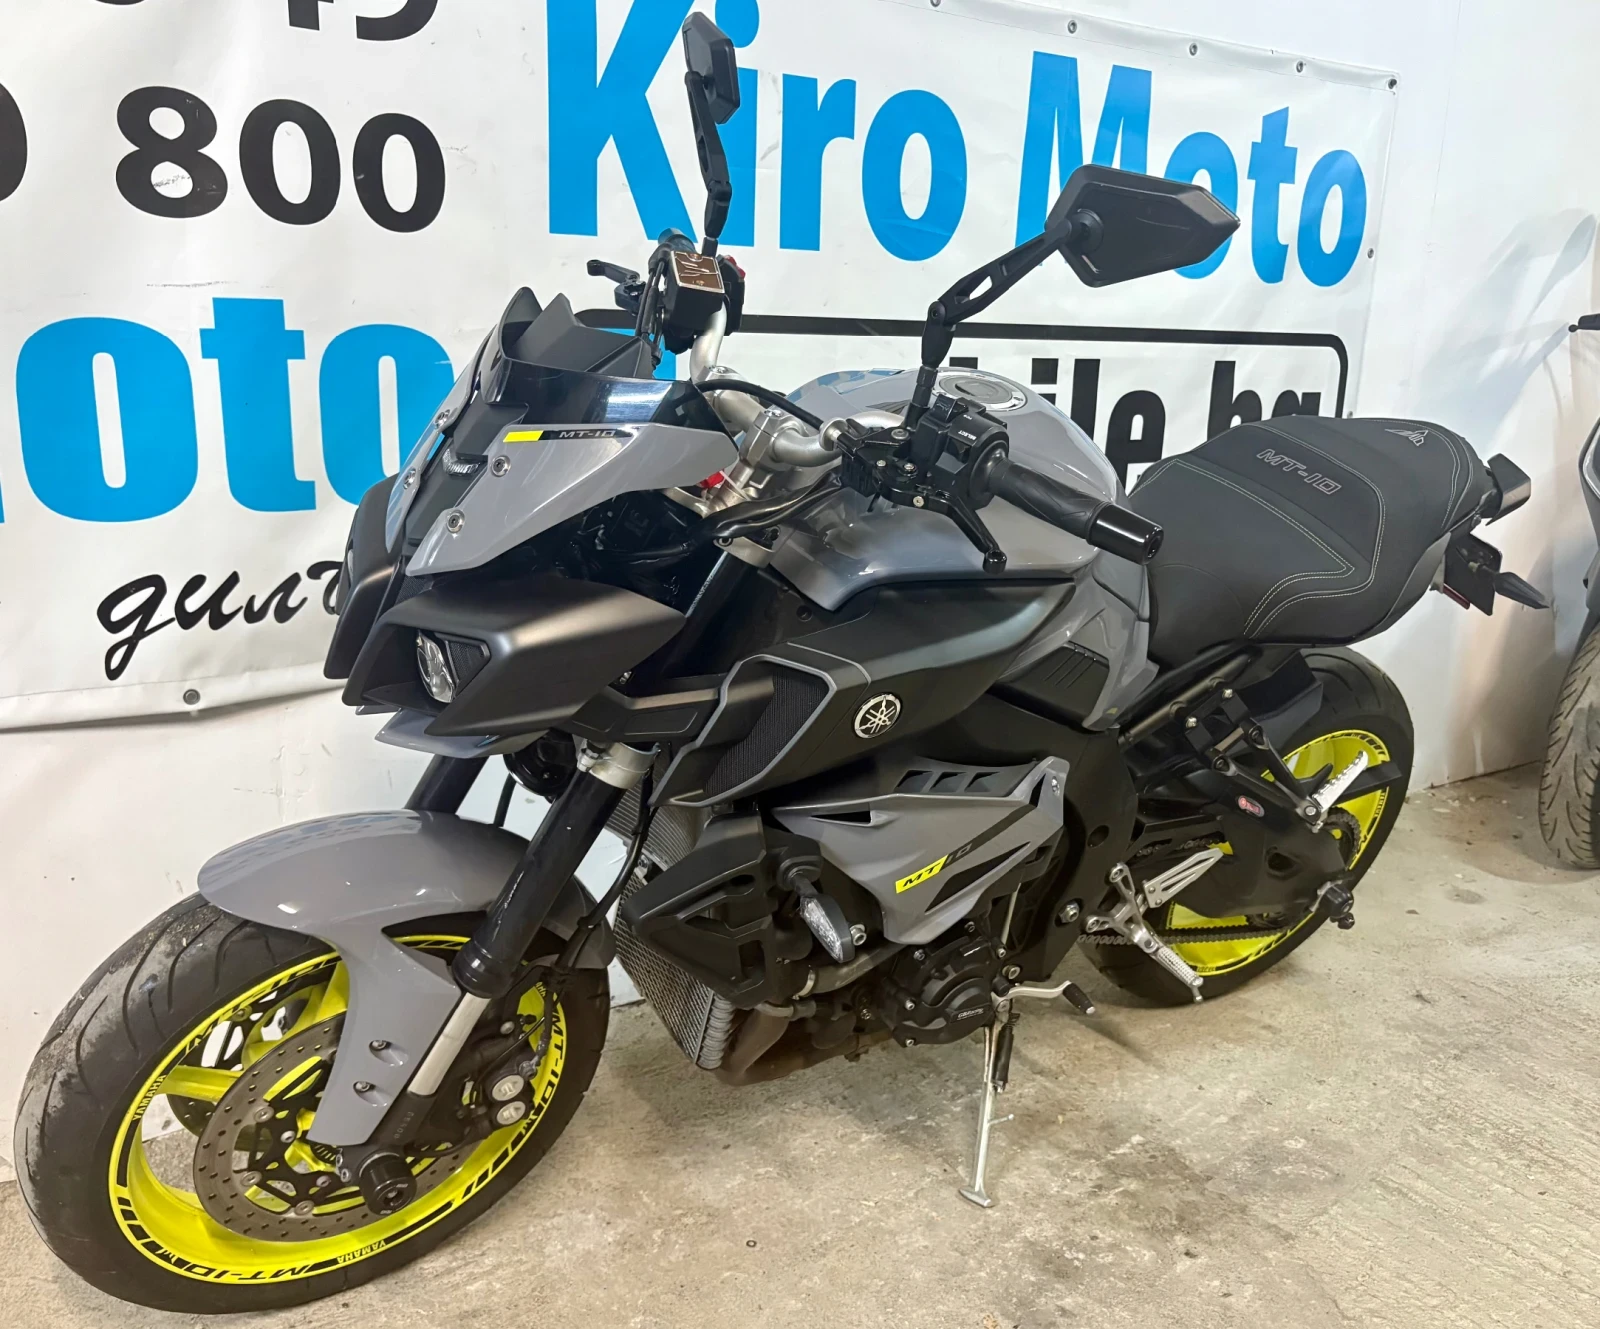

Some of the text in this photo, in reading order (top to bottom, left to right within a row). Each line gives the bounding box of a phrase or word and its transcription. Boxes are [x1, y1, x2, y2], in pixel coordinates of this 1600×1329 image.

[116, 86, 446, 233] 800
[547, 0, 1367, 287] Kiro Moto
[0, 297, 455, 524] oto
[558, 429, 606, 439] MT-10
[1255, 448, 1343, 496] MT-10
[132, 1074, 167, 1121] YAMAHA
[184, 1263, 309, 1282] MT-10
[336, 1239, 387, 1265] YAMAHA
